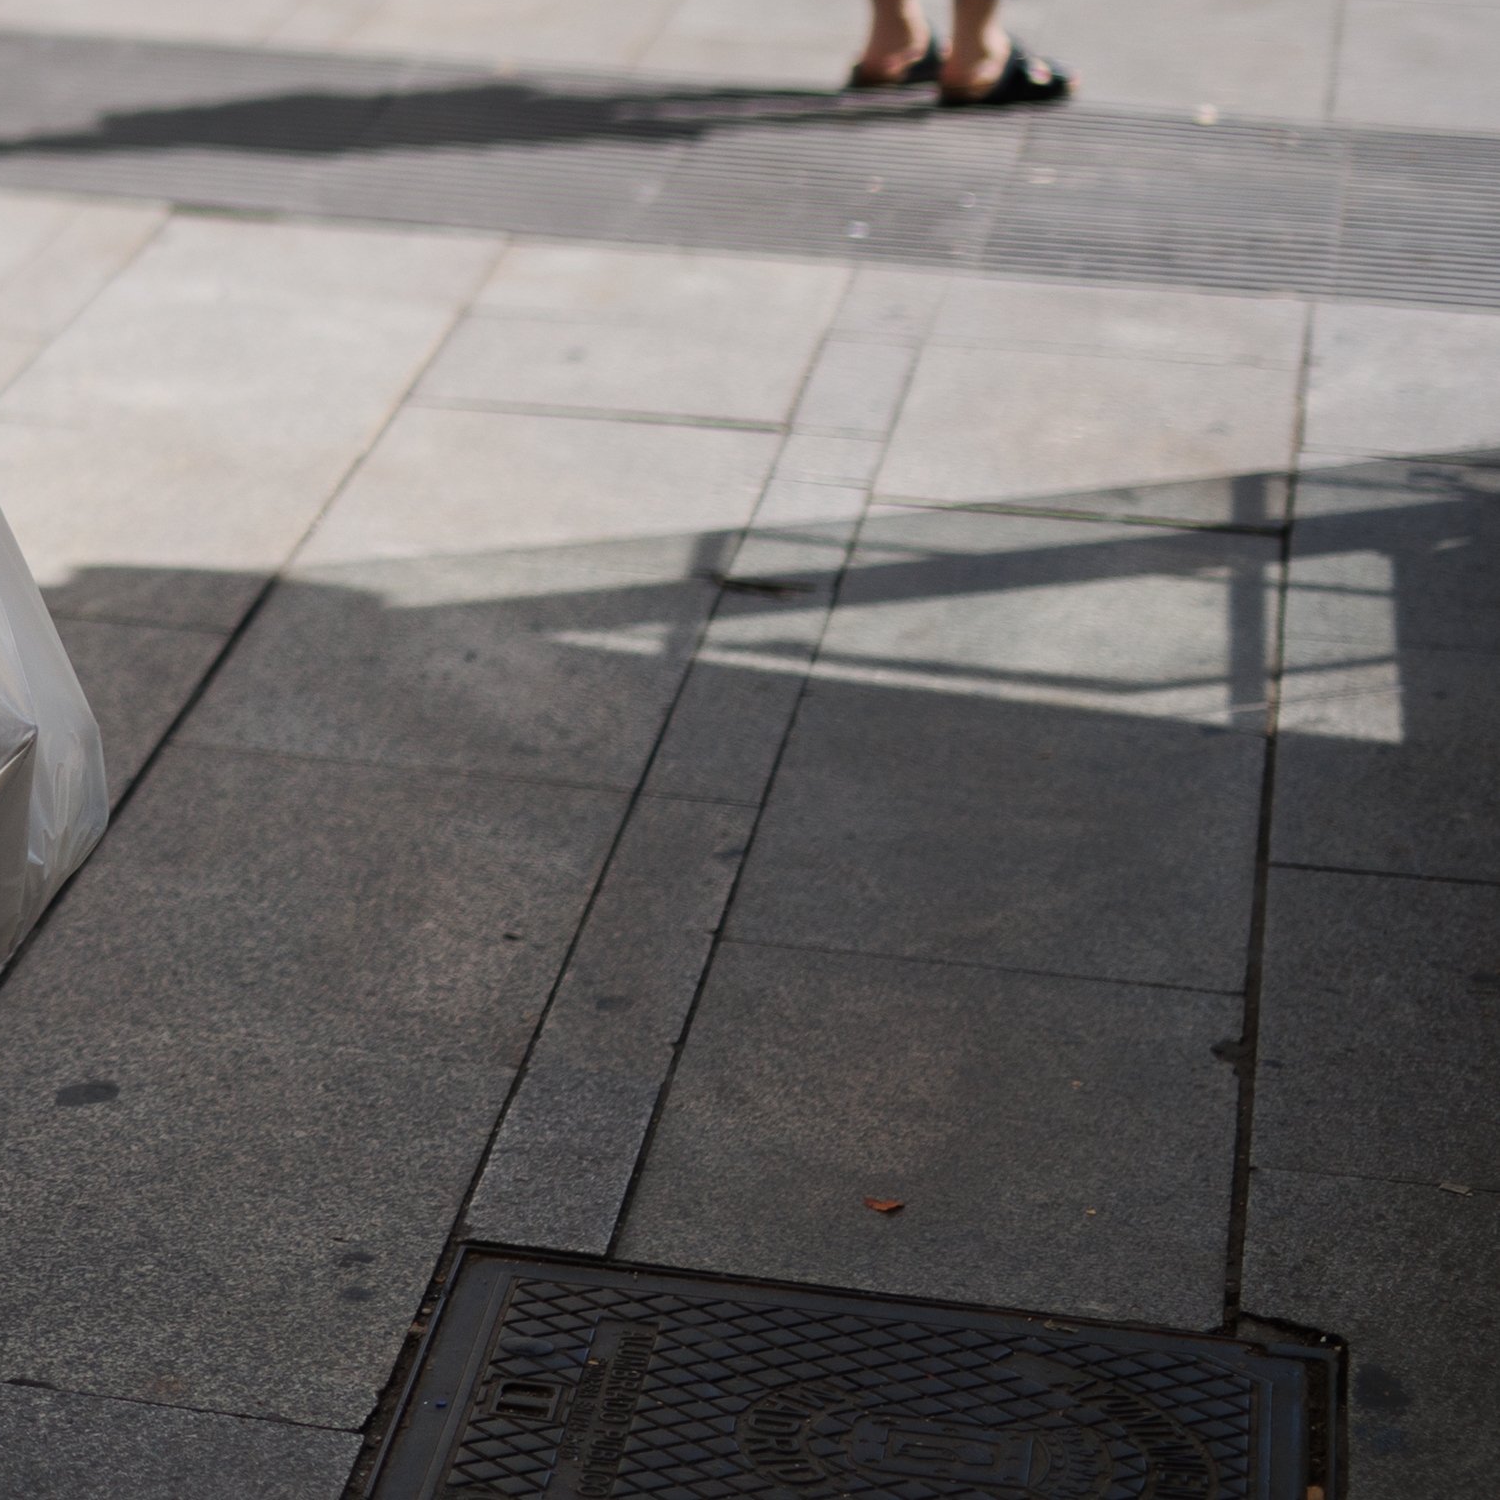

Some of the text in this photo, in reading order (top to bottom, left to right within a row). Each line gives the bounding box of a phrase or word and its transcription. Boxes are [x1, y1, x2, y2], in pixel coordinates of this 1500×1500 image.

[577, 1329, 655, 1498] ALUMBRADO PUBLICO
[744, 1386, 845, 1485] MADRID
